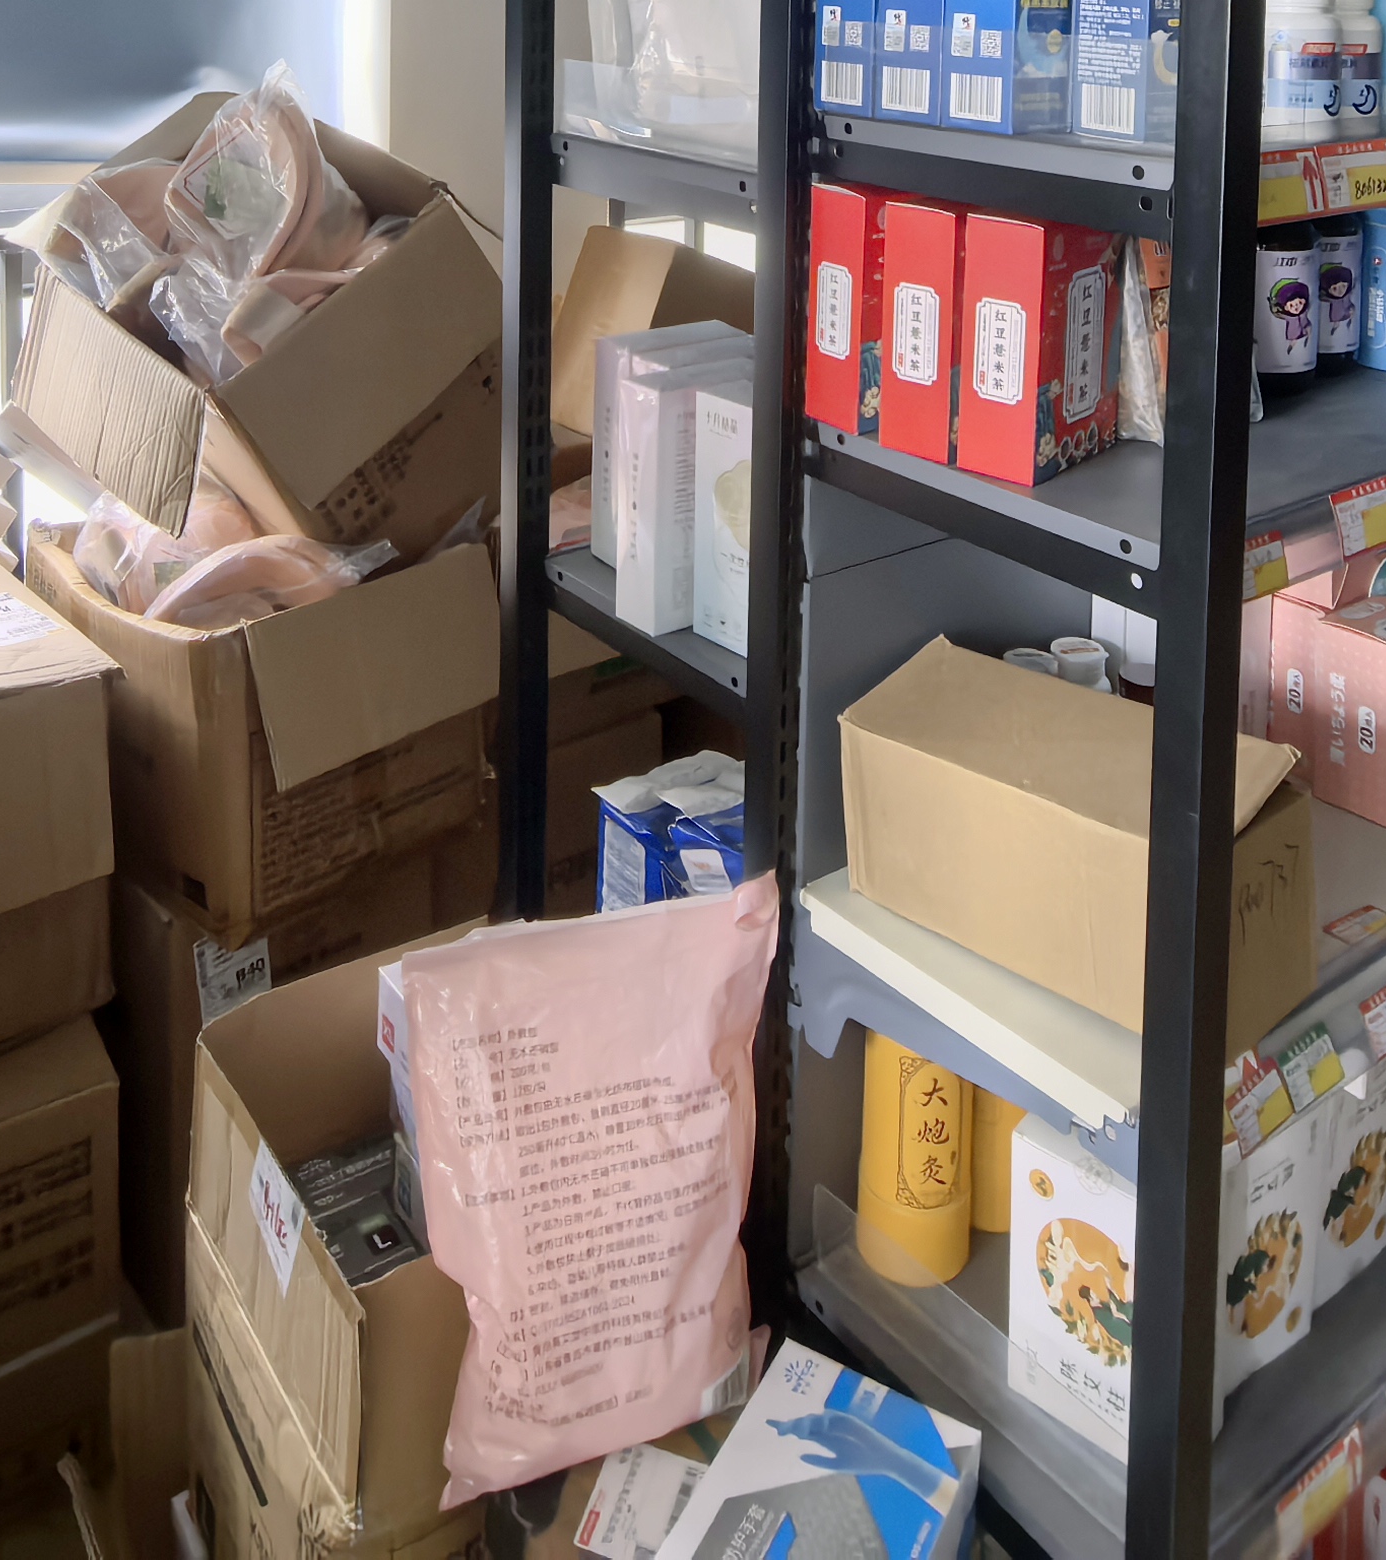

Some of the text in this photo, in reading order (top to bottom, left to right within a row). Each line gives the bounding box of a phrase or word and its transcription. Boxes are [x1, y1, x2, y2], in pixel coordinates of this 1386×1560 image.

[992, 308, 1009, 393] 红豆薏米茶
[916, 1076, 950, 1188] 大炮灸
